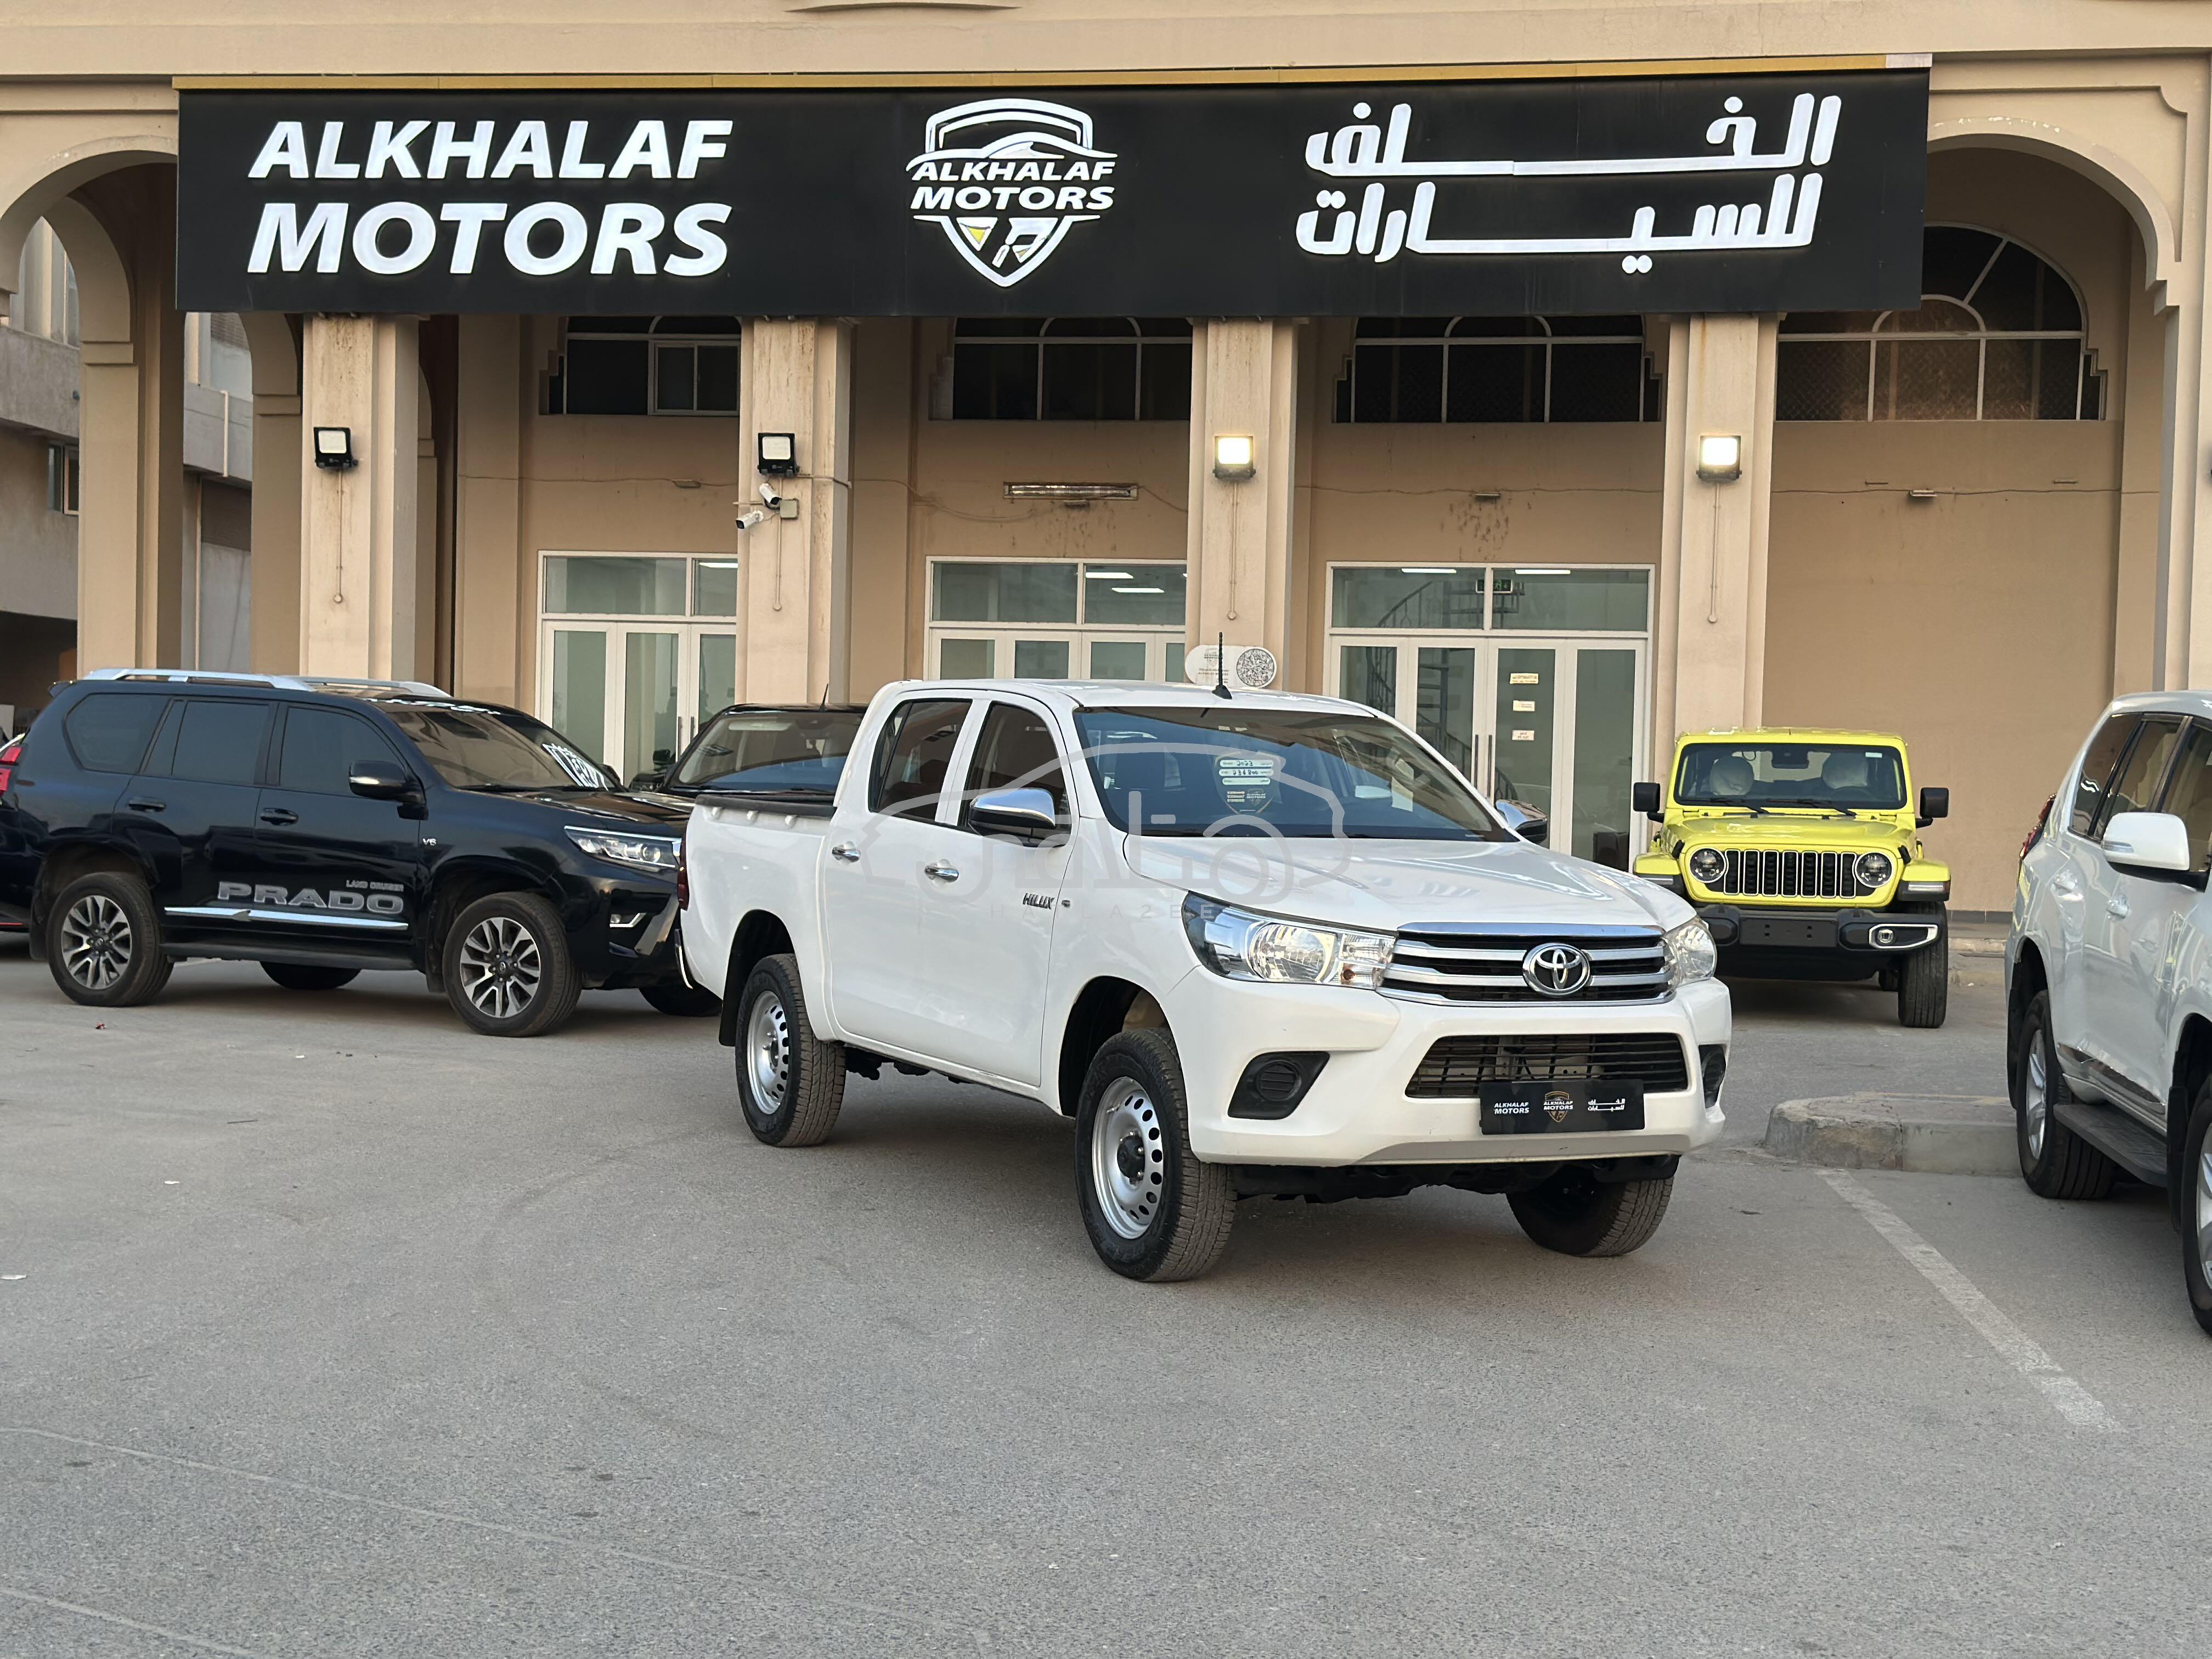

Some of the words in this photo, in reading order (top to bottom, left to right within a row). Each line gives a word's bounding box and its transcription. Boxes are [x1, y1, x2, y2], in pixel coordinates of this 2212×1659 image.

[247, 120, 733, 179] ALKHALAF
[1305, 93, 1842, 177] الخلف
[911, 161, 1116, 181] ALKHALAF
[910, 186, 1115, 210] MOTORS
[247, 201, 732, 276] MOTORS
[1296, 172, 1823, 274] للسيارات
[217, 881, 404, 915] PRADO
[1022, 892, 1054, 910] HILUX
